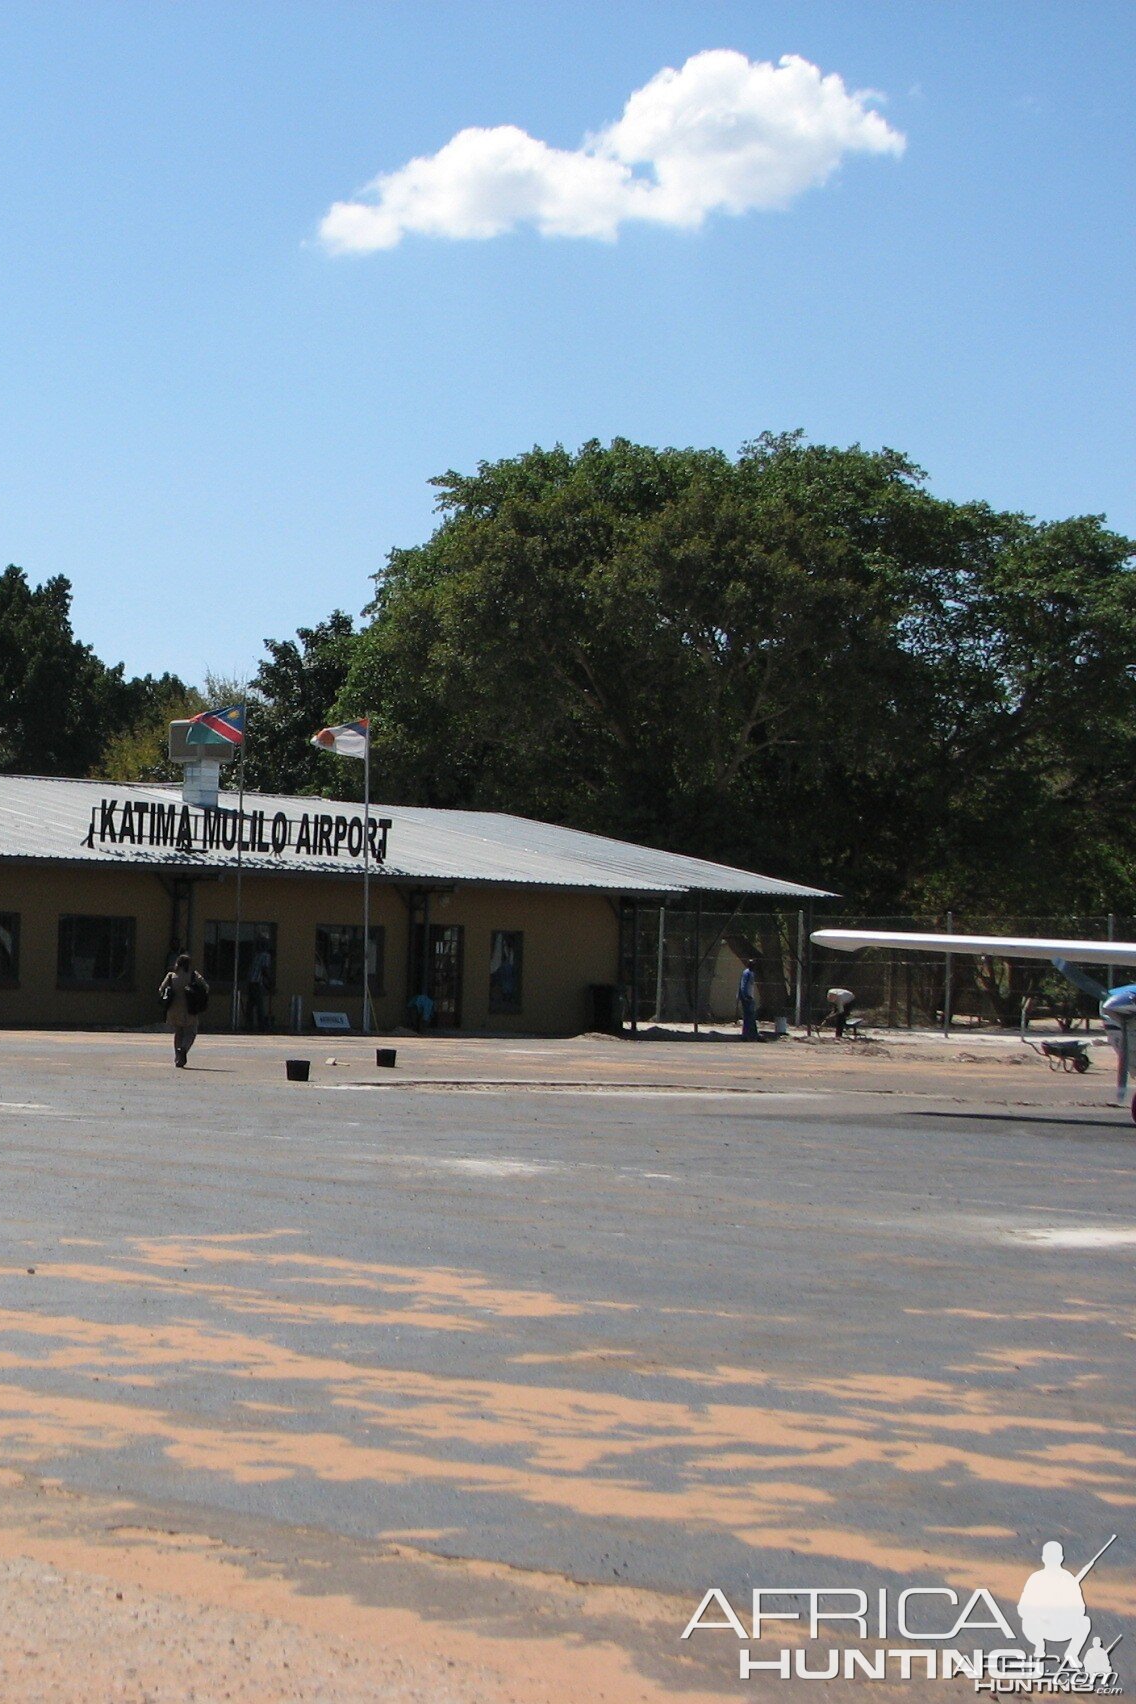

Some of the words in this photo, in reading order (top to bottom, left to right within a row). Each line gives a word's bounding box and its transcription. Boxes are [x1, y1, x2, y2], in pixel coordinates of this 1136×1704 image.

[100, 799, 193, 847] KATIMA
[203, 806, 287, 852] MULILO
[296, 813, 392, 859] AIRPORT
